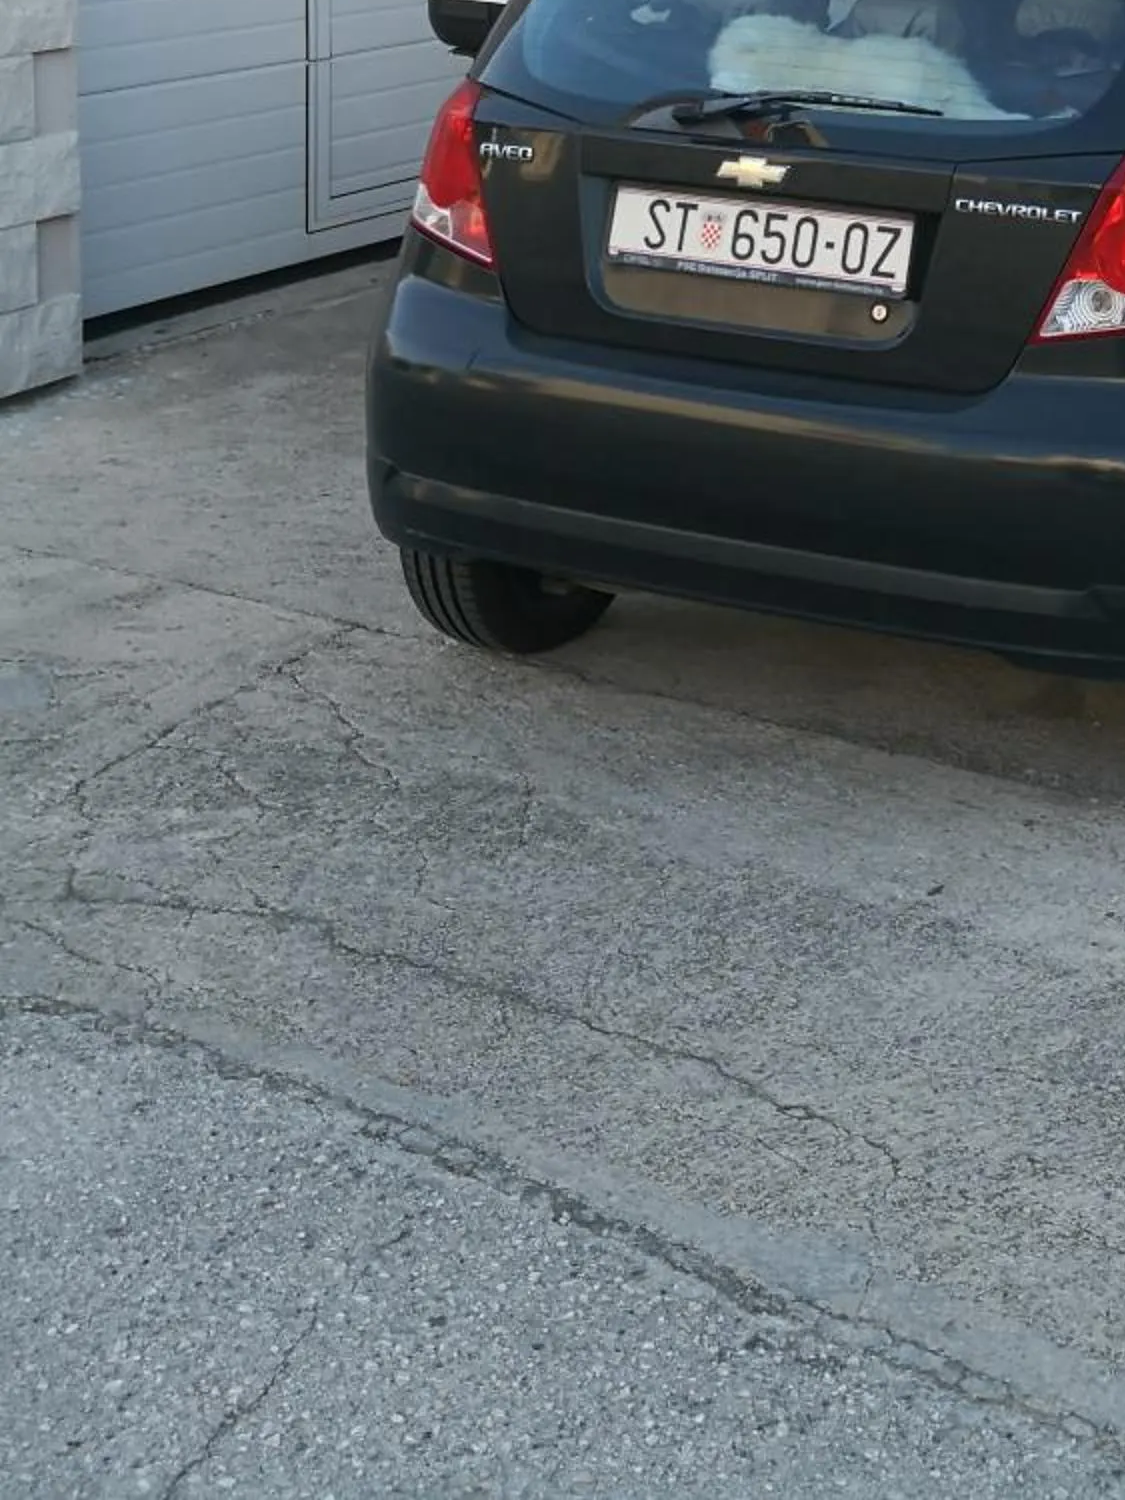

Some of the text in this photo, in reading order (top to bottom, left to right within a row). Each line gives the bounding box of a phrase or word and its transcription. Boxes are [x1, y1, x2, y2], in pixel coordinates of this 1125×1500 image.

[480, 142, 534, 160] AVEO
[955, 198, 1083, 224] CHEVROLET
[643, 199, 699, 252] ST
